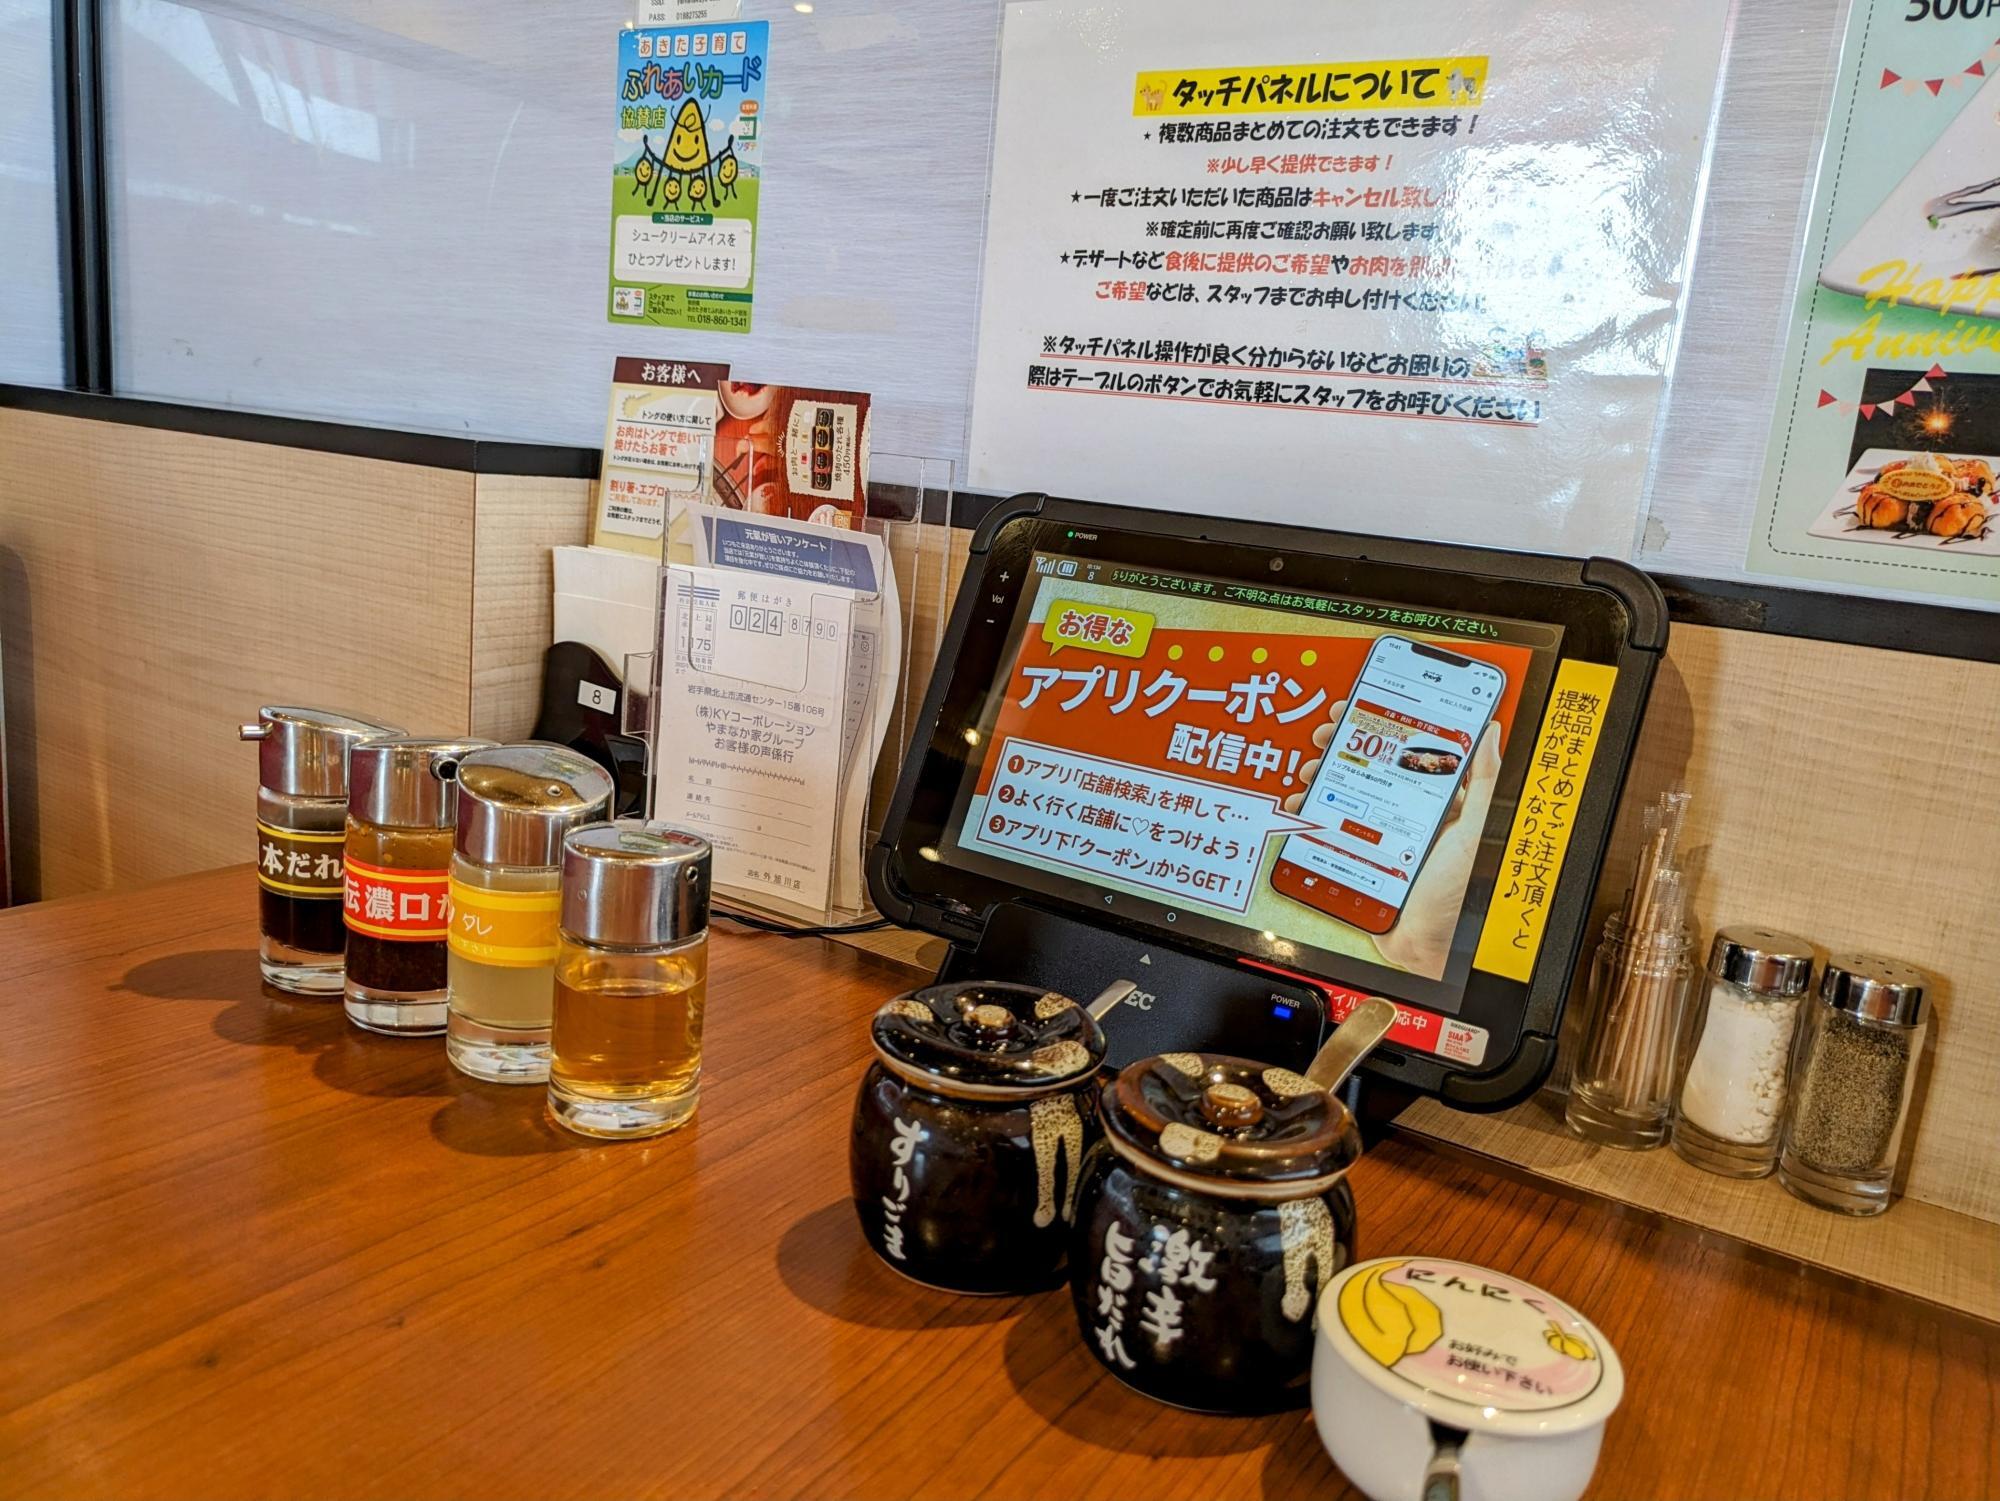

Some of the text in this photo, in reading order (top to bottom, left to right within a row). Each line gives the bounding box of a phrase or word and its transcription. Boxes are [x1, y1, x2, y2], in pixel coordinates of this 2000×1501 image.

[640, 34, 745, 56] あきた子育て
[621, 55, 762, 101] ふれあいカード
[1172, 67, 1440, 109] タッチパネルについて
[621, 105, 667, 130] 協賛店
[632, 229, 737, 247] シュークリームアイスを
[628, 252, 736, 271] ひとつプレゼントします！
[641, 363, 701, 384] お客様へ
[642, 410, 711, 425] トングの使い方に関して
[834, 416, 845, 481] 焼肉のたれ各種
[1075, 532, 1097, 541] POWER
[1088, 571, 1095, 580] 8
[737, 590, 792, 607] 郵便はがき
[992, 594, 1004, 604] Vol
[1057, 609, 1135, 646] お得な
[592, 690, 601, 704] 8
[1018, 664, 1327, 724] アプリクーポン
[695, 704, 816, 736] (株)KYコーポレーション
[705, 721, 804, 749] やまなか家グループ
[1346, 729, 1383, 758] 50
[714, 738, 794, 763] お客様の声係行
[1166, 722, 1301, 787] 配信中！
[1512, 691, 1601, 949] 数品まとめてご注文頂くと
[259, 842, 344, 880] 本だれ
[1271, 993, 1300, 1009] POWER
[883, 1117, 921, 1261] すりごま
[1095, 1221, 1137, 1370] 旨だれ
[1140, 1225, 1218, 1344] 激辛
[1406, 1267, 1546, 1314] にんにく
[1448, 1339, 1518, 1366] お好みで
[1447, 1355, 1554, 1396] お使い下さい
